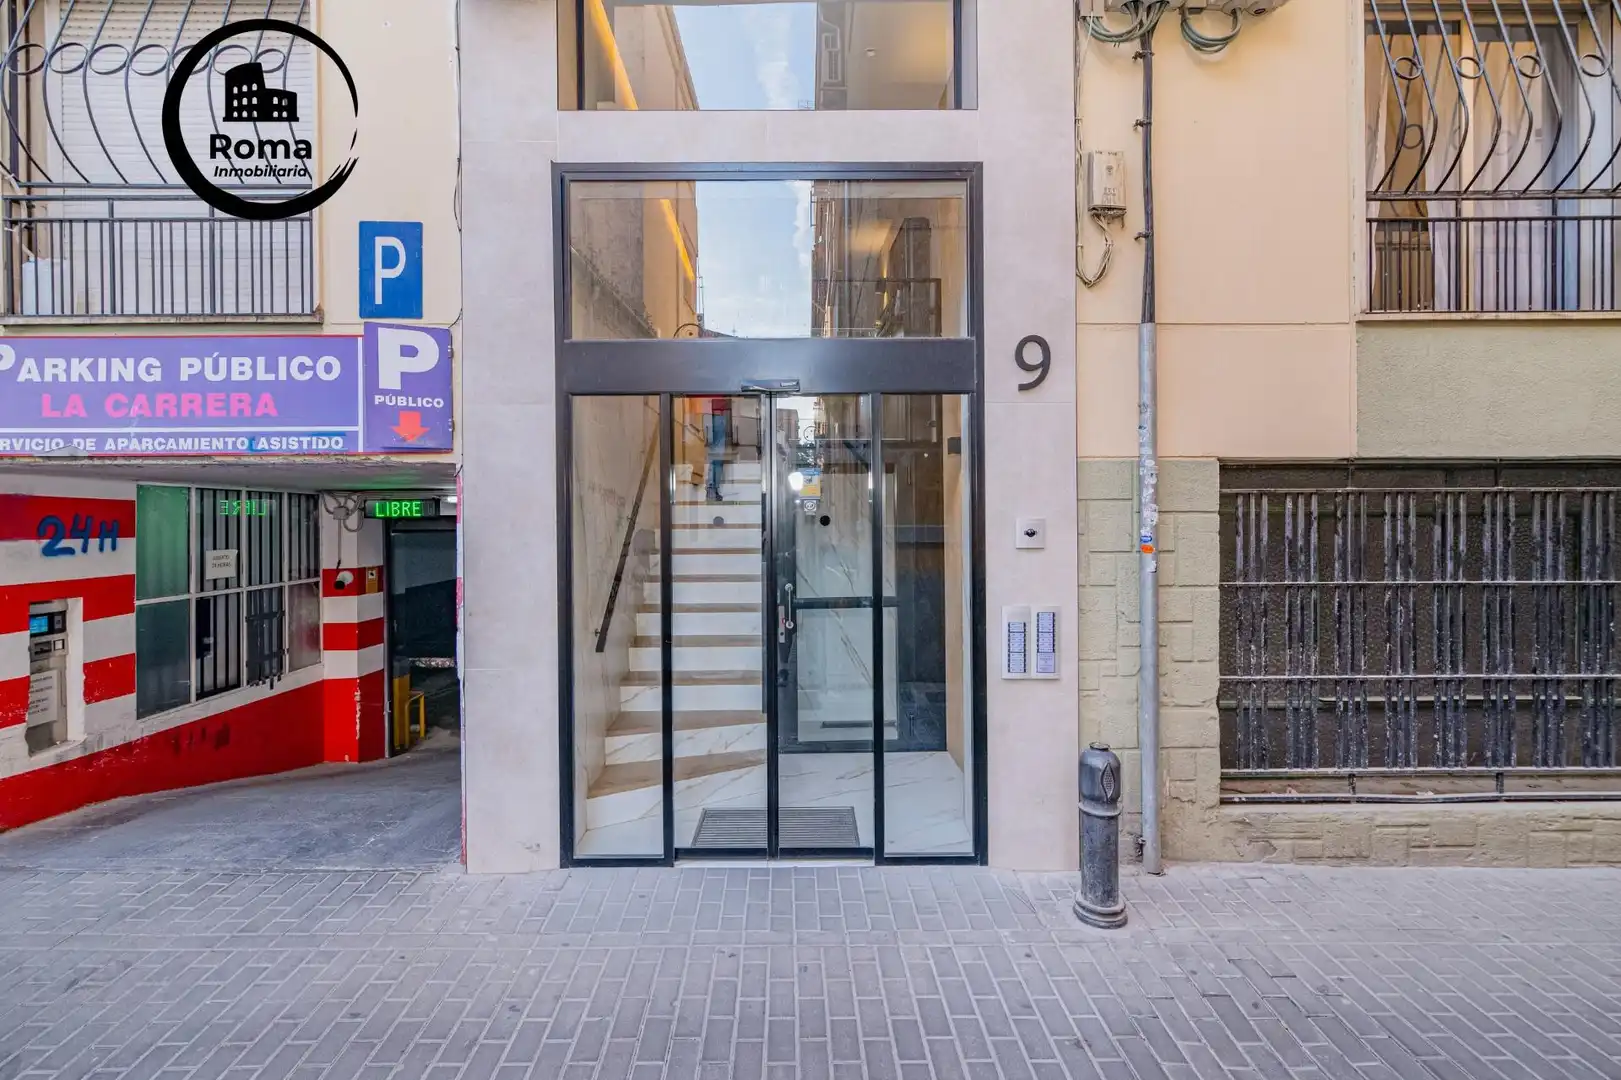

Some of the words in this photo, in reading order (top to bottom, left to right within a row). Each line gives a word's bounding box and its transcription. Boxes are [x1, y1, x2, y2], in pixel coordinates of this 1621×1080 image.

[375, 236, 406, 305] P
[180, 352, 341, 381] PÚBLICO
[378, 327, 440, 390] P
[1014, 335, 1051, 391] 9
[41, 393, 88, 418] LA
[104, 392, 279, 418] CARRERA
[374, 394, 445, 408] PÚBLICO
[73, 438, 97, 451] DE
[105, 437, 249, 451] APARCAMIENTO
[257, 436, 344, 450] ASISTIDO
[375, 501, 421, 517] LIBRE
